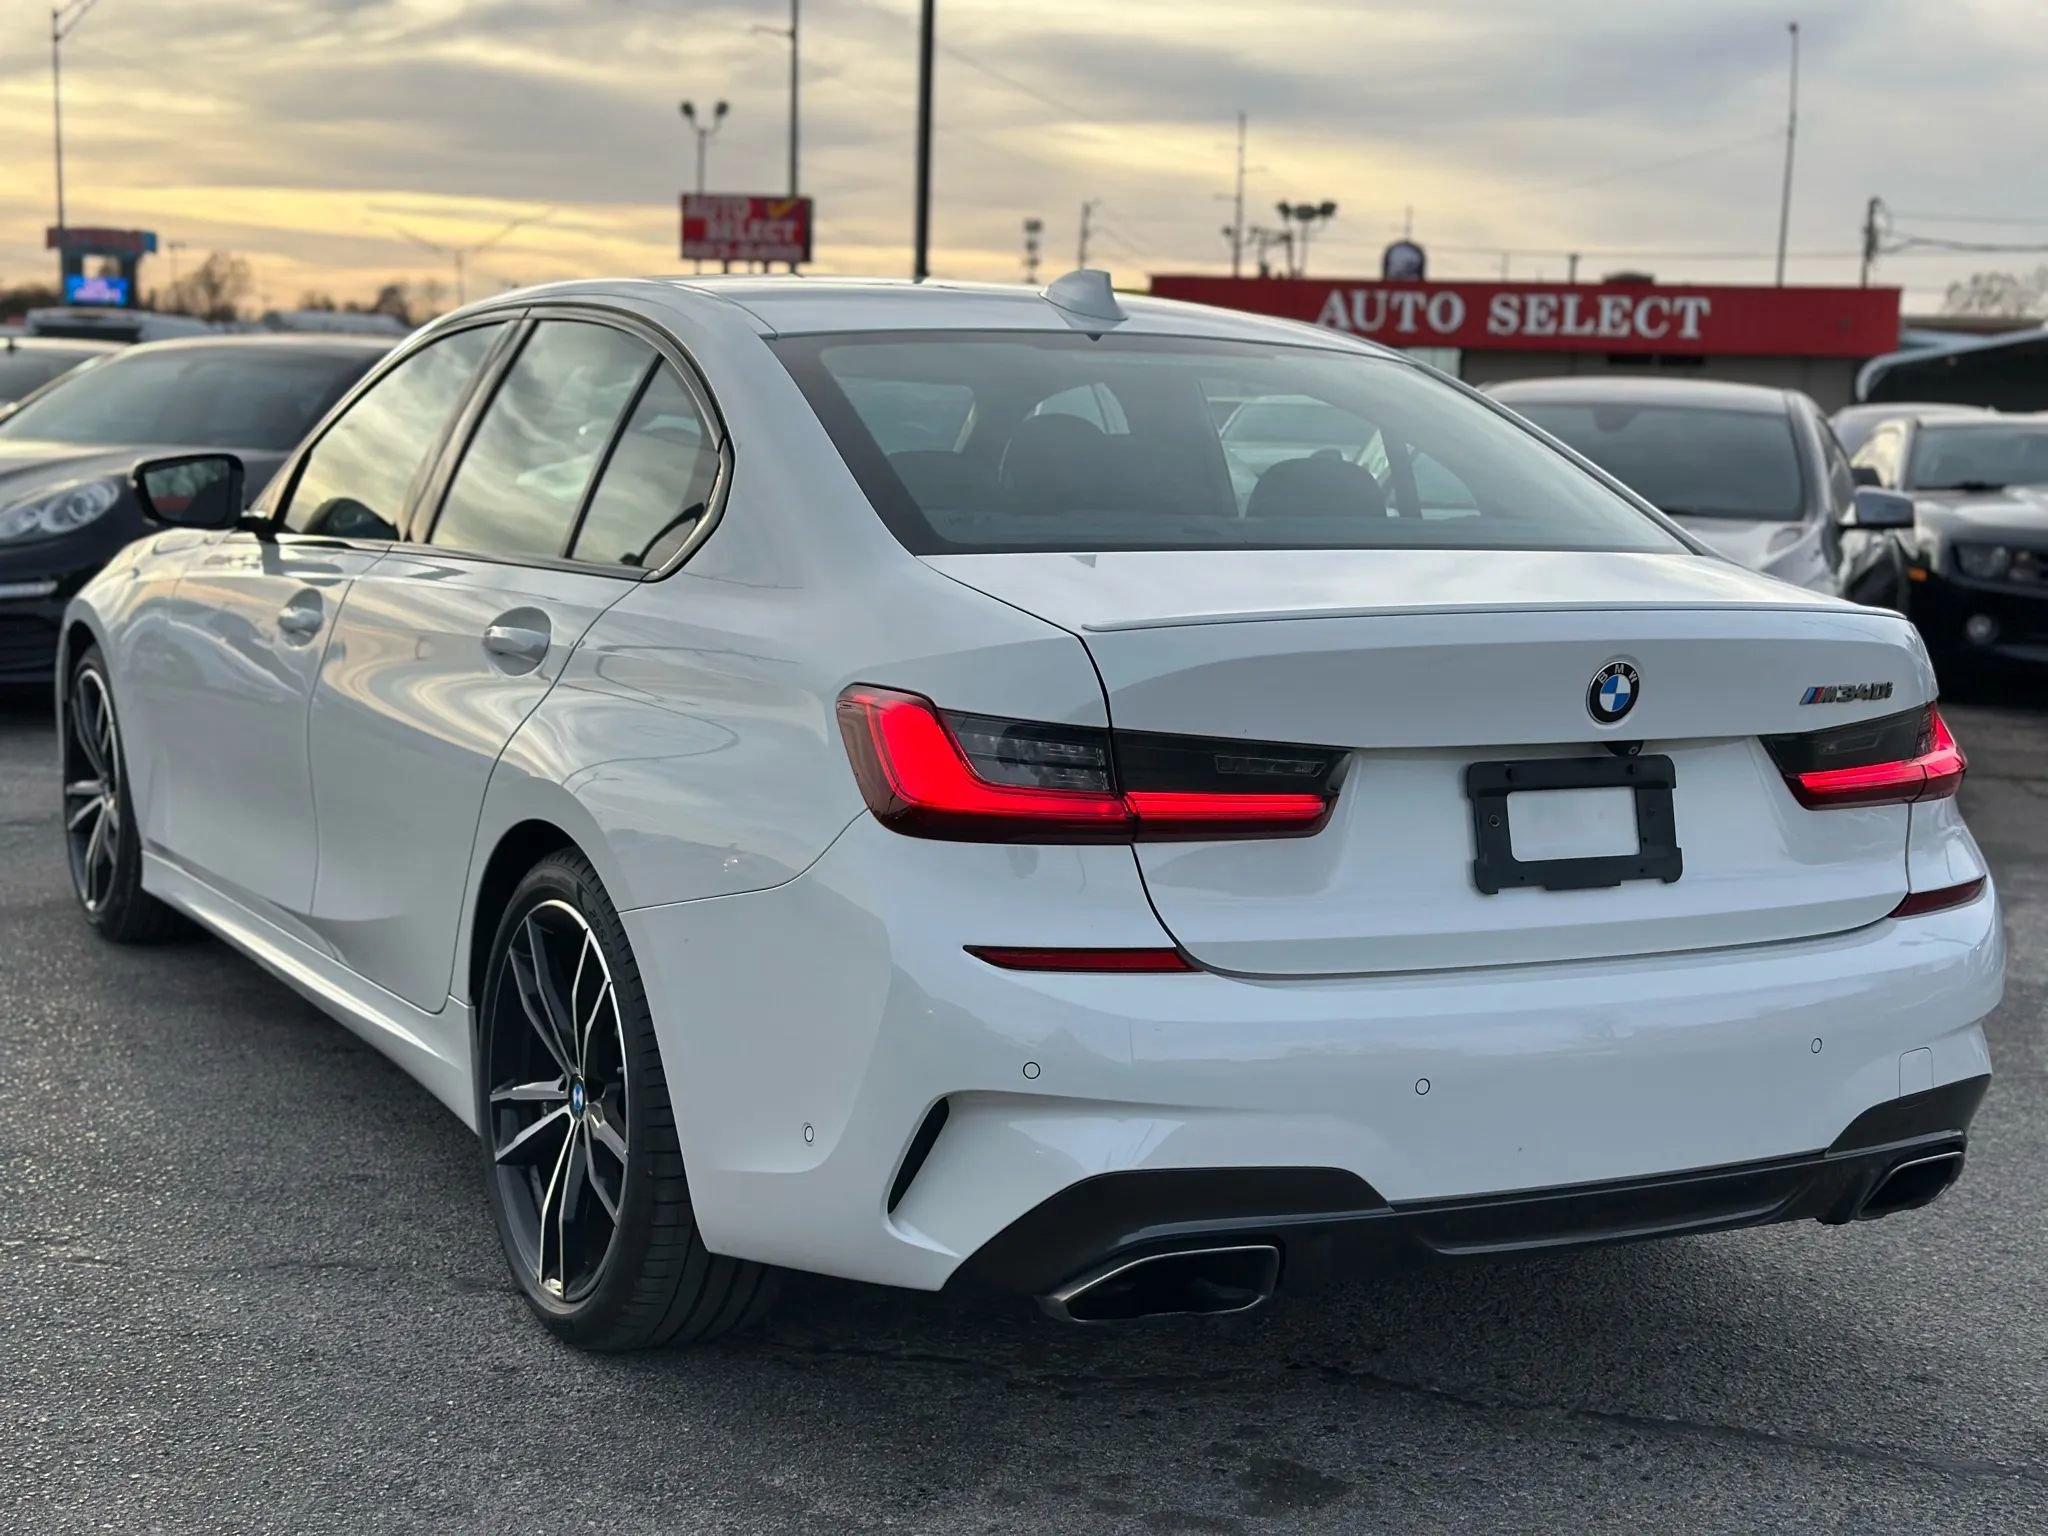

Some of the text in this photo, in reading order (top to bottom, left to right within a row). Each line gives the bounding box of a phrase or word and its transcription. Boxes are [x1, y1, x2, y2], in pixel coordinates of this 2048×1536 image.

[705, 219, 797, 242] SELECT
[1315, 287, 1711, 339] AUTO SELECT
[1597, 663, 1638, 684] BMW
